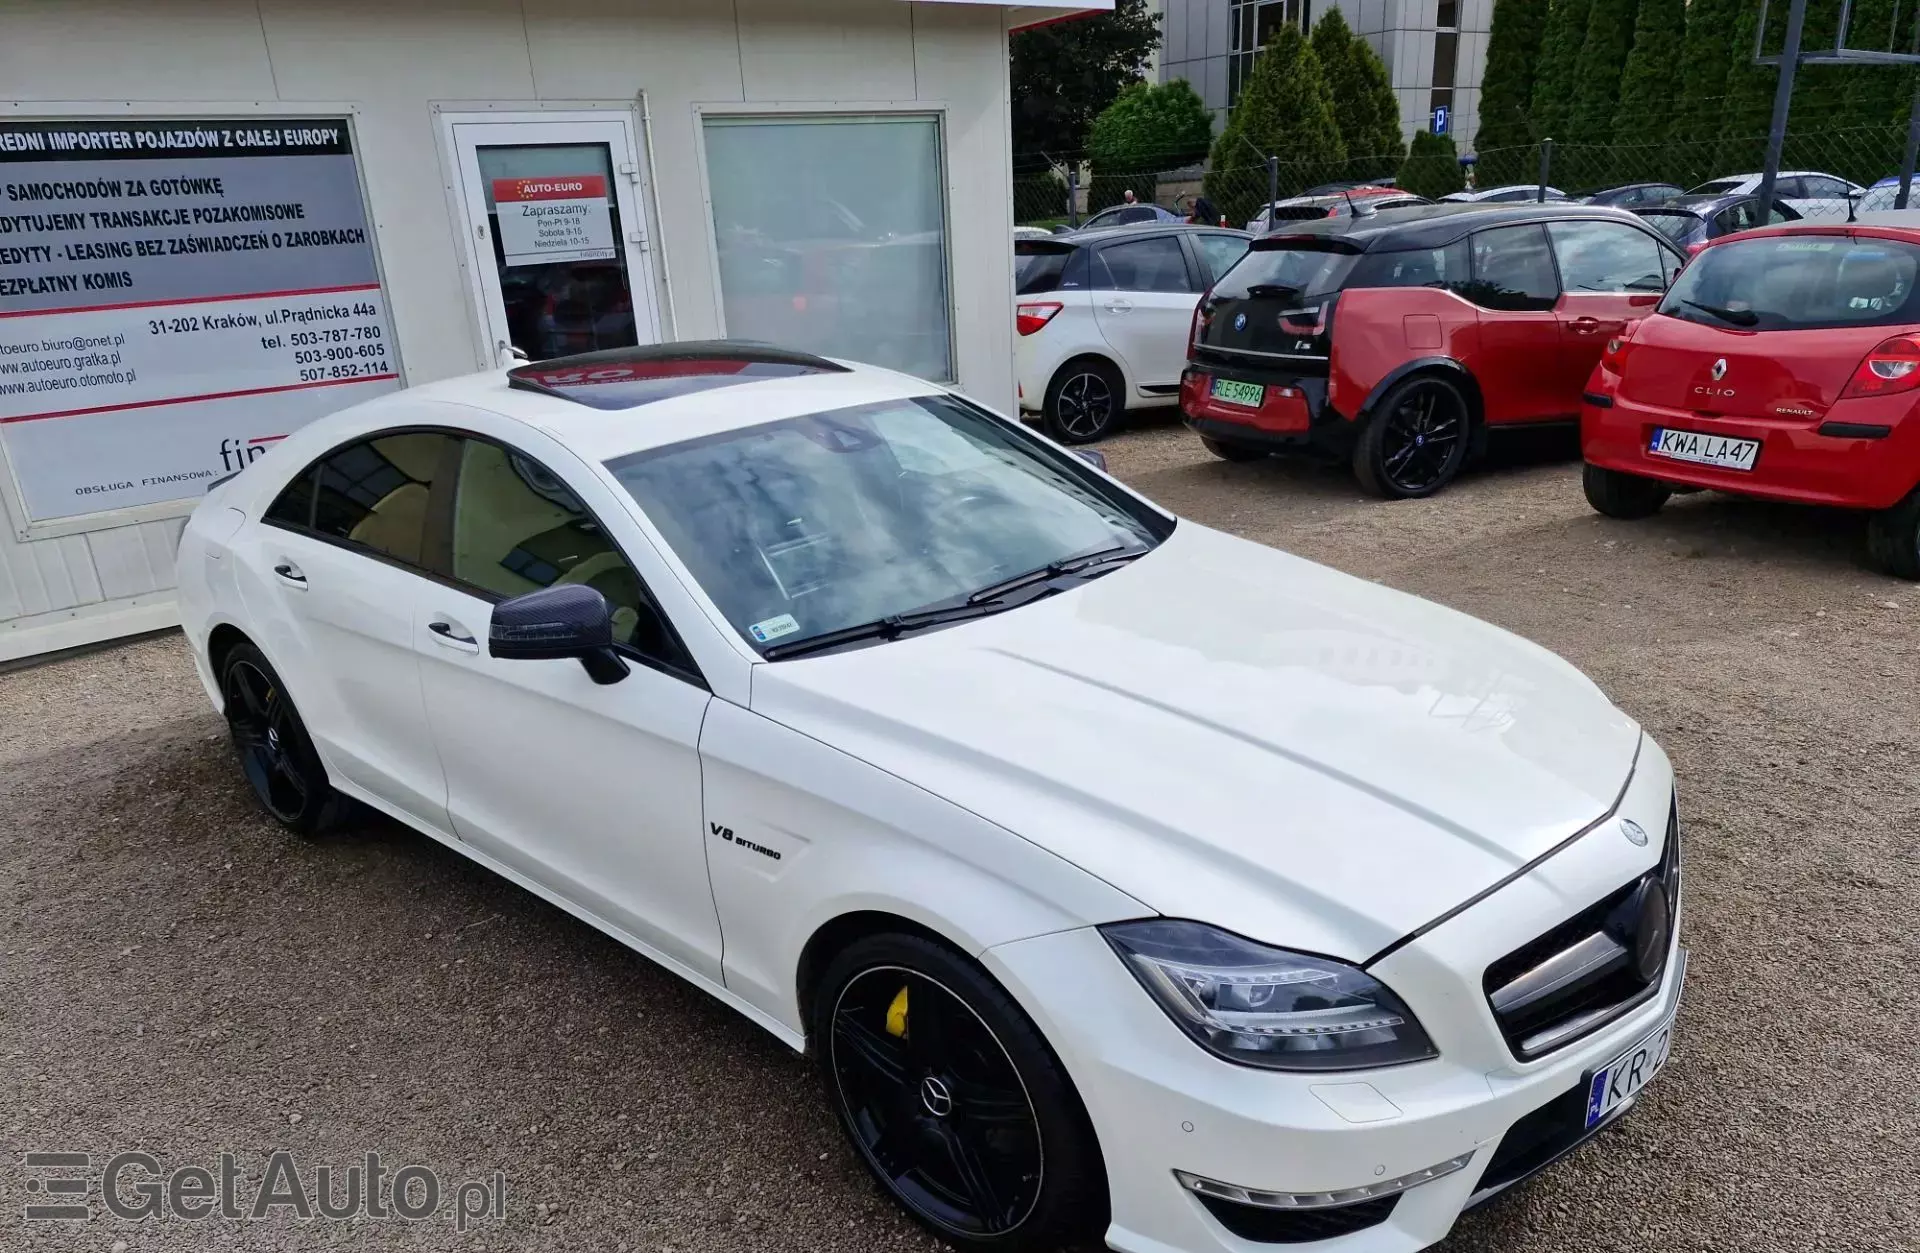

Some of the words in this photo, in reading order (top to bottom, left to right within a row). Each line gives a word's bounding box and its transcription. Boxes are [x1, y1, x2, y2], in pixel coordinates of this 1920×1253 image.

[1436, 109, 1445, 132] P
[48, 131, 133, 150] IMPORTER
[134, 126, 219, 149] POJAZDÓW
[221, 130, 234, 147] Z
[235, 129, 281, 147] CAŁEJ
[284, 128, 339, 147] EUROPY
[6, 177, 122, 201] SAMOCHODÓW
[125, 180, 148, 197] ZA
[150, 174, 225, 198] GOTÓWKĘ
[523, 182, 583, 194] AUTO-EURO
[0, 213, 87, 233] DYTUJEMY
[89, 208, 191, 229] TRANSAKCJE
[193, 203, 305, 224] POZAKOMISOWE
[64, 240, 133, 261] LEASING
[134, 239, 166, 257] BEZ
[167, 229, 269, 255] ZAŚWIADCZEŃ
[271, 232, 282, 249] O
[284, 228, 366, 248] ZAROBKACH
[534, 239, 568, 249] Niedziela
[538, 229, 565, 238] Sobota
[82, 270, 133, 291] KOMIS
[149, 317, 200, 335] 31-202
[202, 312, 262, 331] Kraków,
[264, 304, 350, 326] ul.Prądnicka
[352, 302, 377, 317] 44a
[261, 335, 287, 350] tel.
[290, 325, 382, 347] 503-787-780
[294, 343, 386, 365] 503-900-605
[299, 360, 390, 382] 507-852-114
[1694, 386, 1735, 397] CLIO
[1776, 407, 1814, 416] RENAULT
[1661, 431, 1698, 455] KWA
[1704, 437, 1755, 462] LA47
[75, 480, 134, 496] OBSŁUGA
[141, 469, 218, 488] FINANSOWA:
[710, 821, 734, 841] V8
[735, 837, 782, 860] BITURBO
[1607, 1049, 1647, 1107] KR
